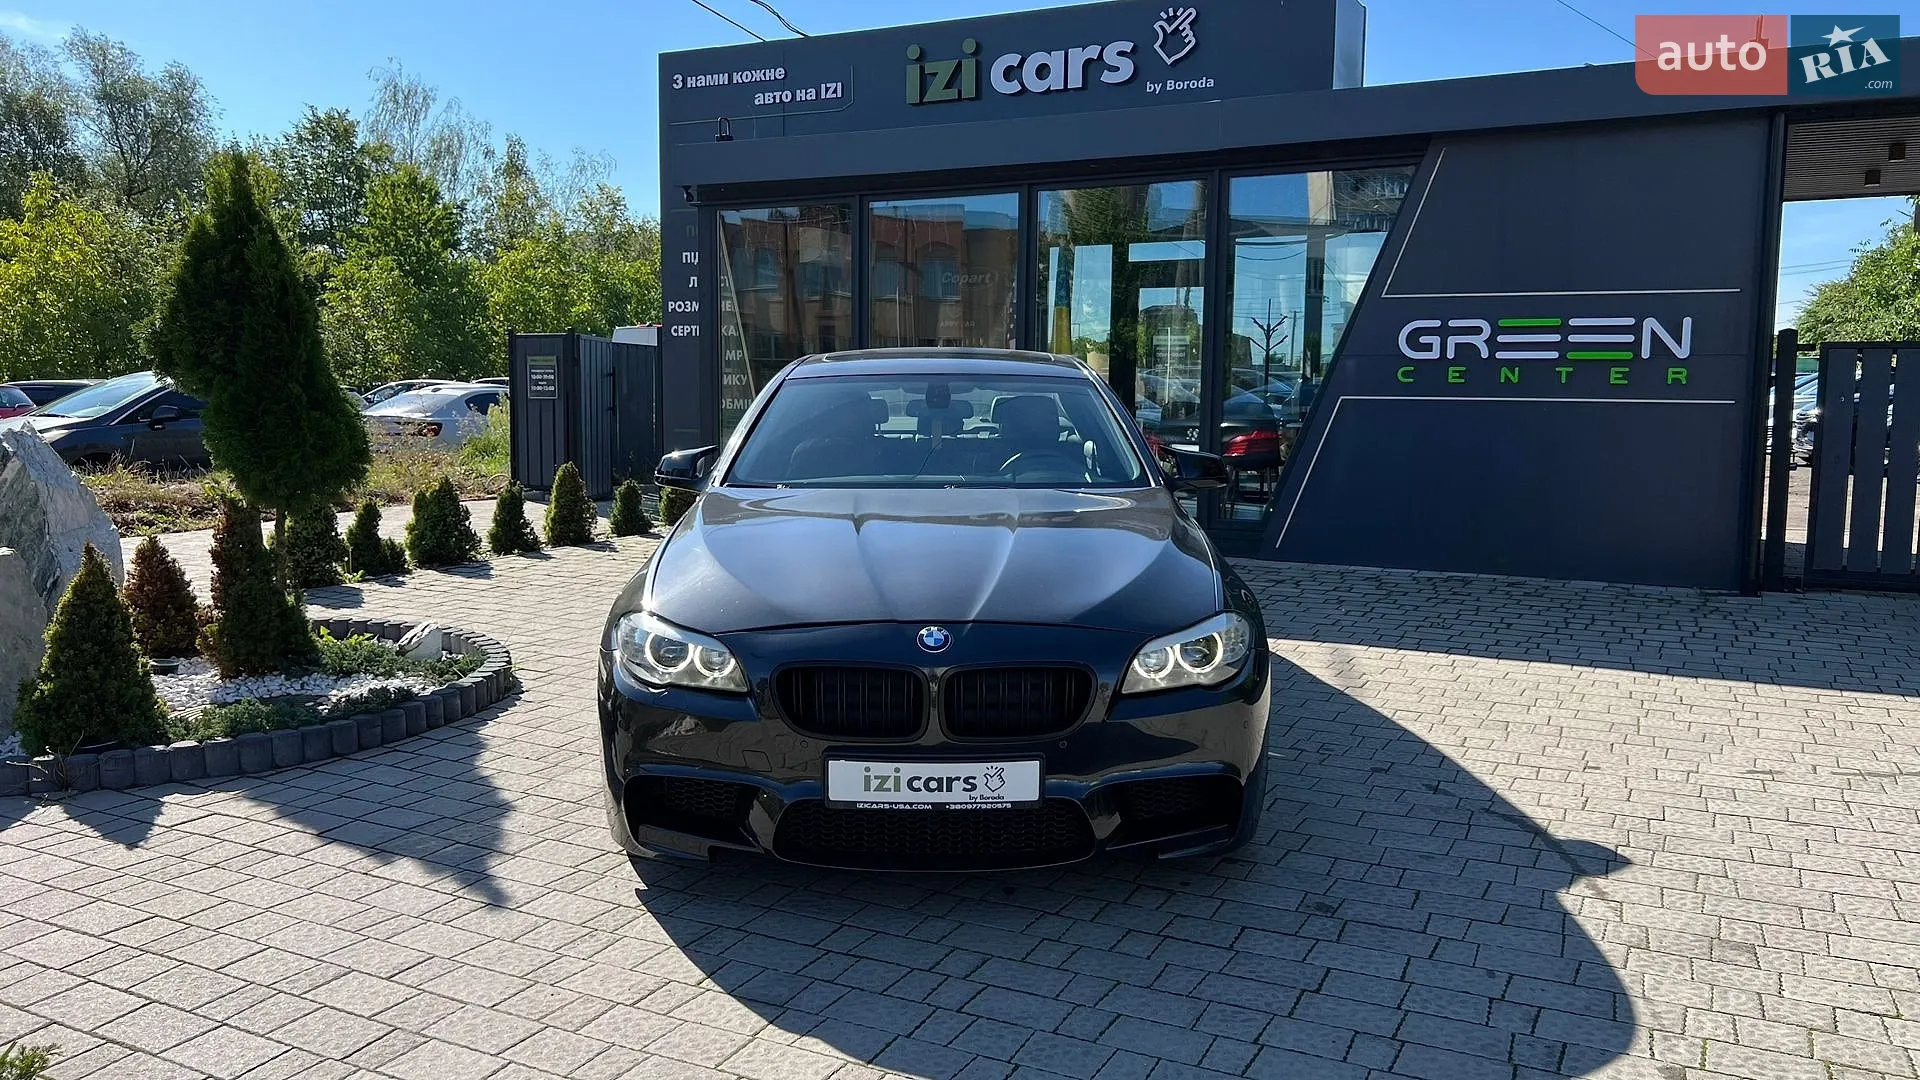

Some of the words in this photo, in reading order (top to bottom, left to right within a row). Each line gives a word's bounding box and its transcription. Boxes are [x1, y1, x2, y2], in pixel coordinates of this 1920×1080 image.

[687, 72, 729, 88] нами
[732, 67, 786, 83] кожне
[906, 38, 977, 104] izi
[990, 40, 1135, 94] cars
[754, 90, 792, 105] авто
[796, 88, 816, 101] на
[820, 82, 842, 98] IZI
[1146, 80, 1161, 94] by
[1166, 77, 1214, 91] Boroda
[1398, 316, 1692, 359] GREEN
[1397, 367, 1688, 384] CENTER
[863, 766, 901, 793] izi
[906, 774, 978, 793] cars
[968, 794, 978, 802] by
[980, 793, 1005, 801] Boroda
